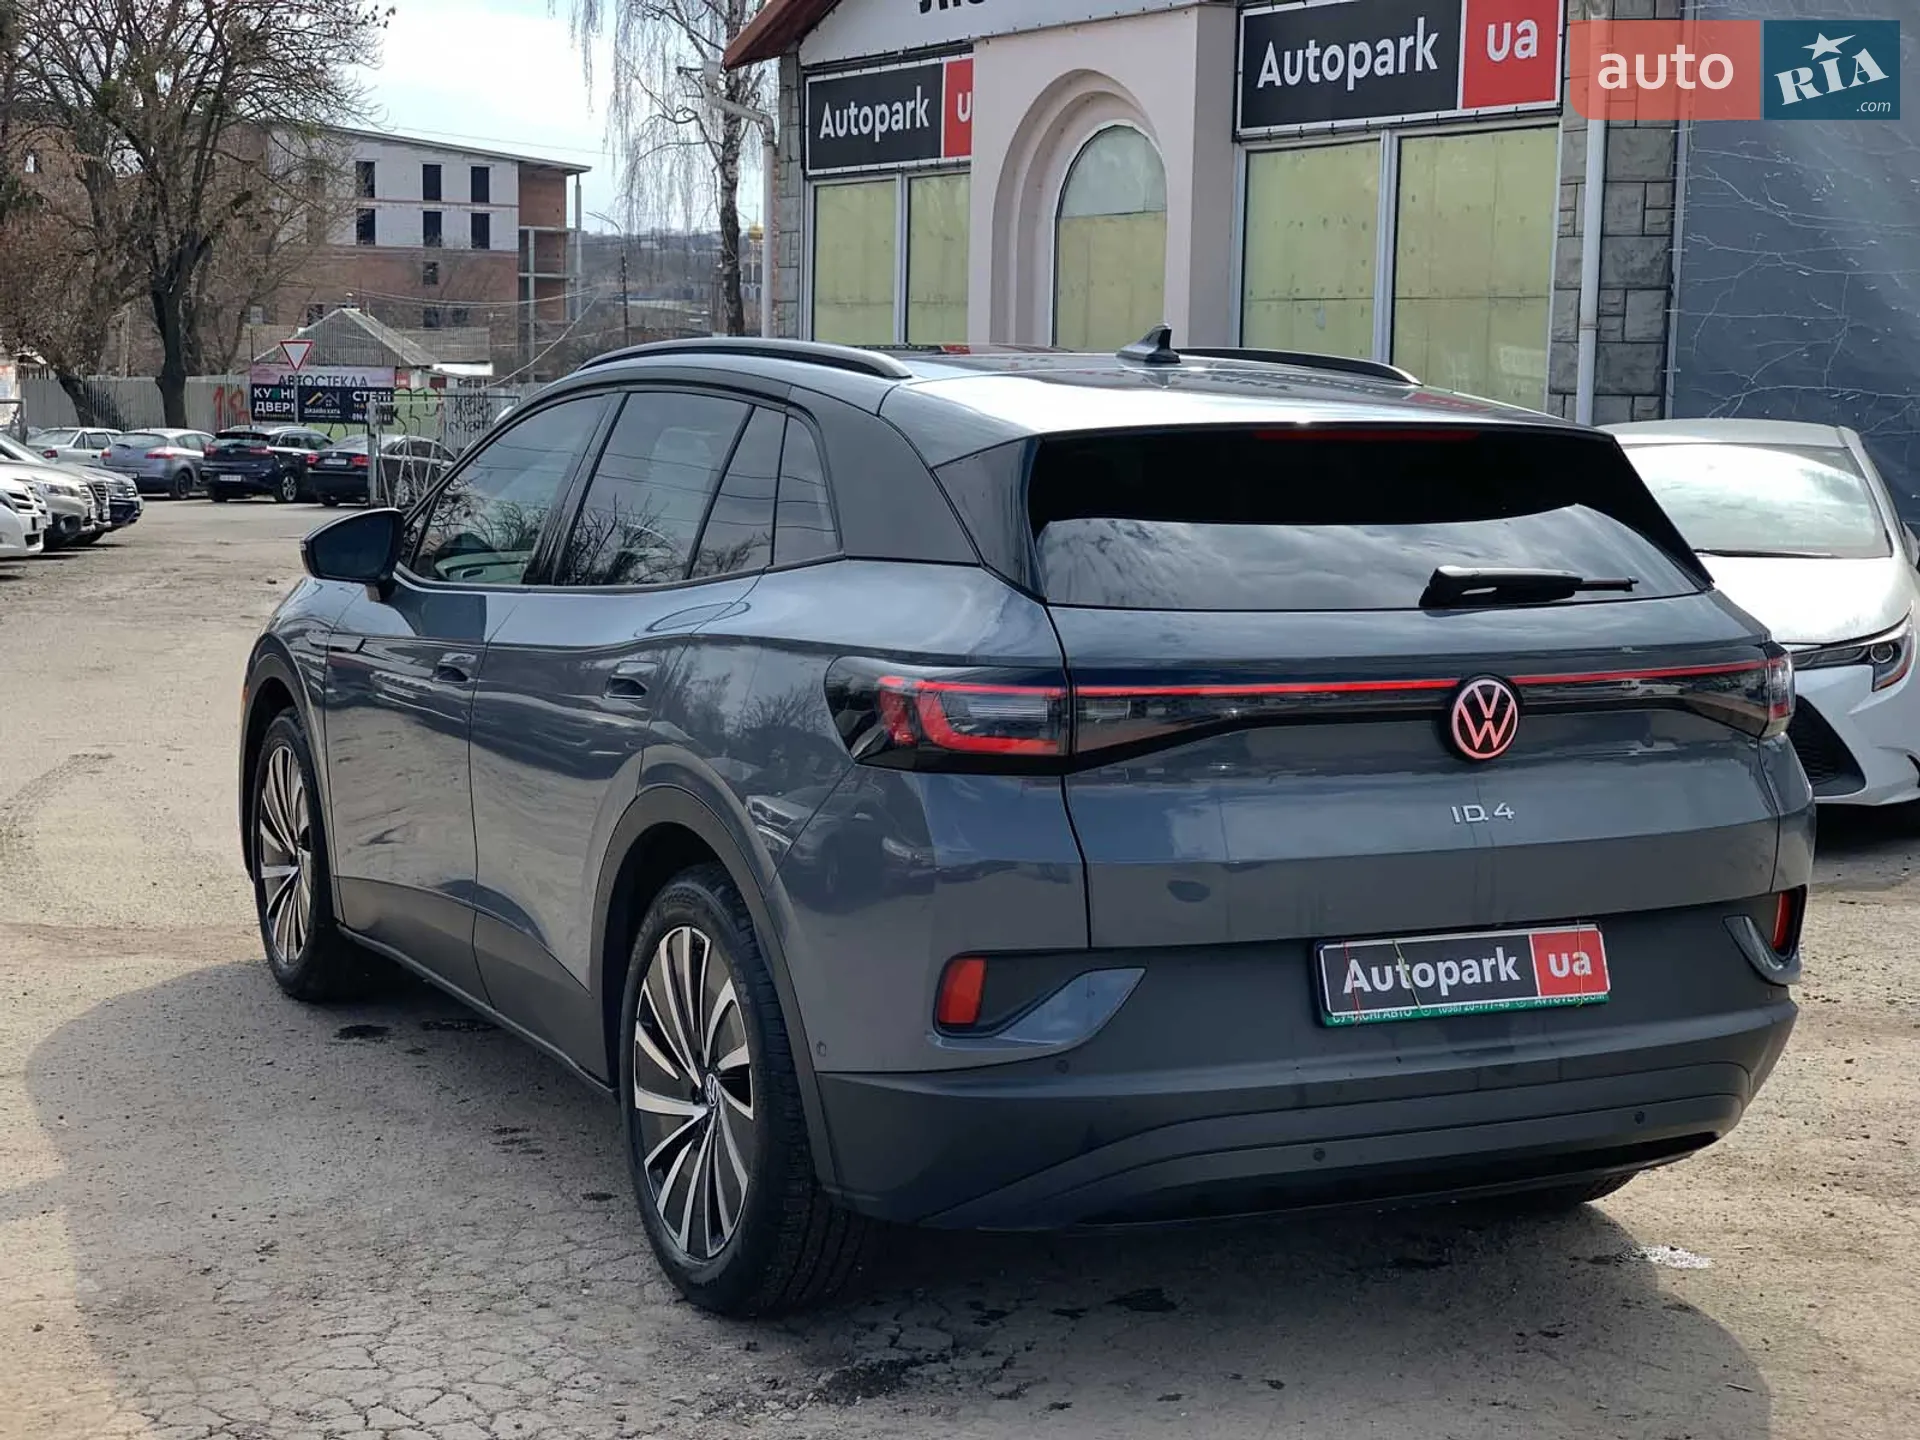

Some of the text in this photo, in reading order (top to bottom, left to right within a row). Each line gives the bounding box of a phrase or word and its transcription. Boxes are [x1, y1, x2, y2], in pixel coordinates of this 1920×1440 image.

[1257, 16, 1539, 91] Autopark ua
[819, 85, 930, 142] Autopark
[278, 374, 368, 388] АВТОСТЕКЛА
[254, 401, 294, 414] ДВЕРІ
[1450, 803, 1516, 824] ID.4
[1343, 946, 1592, 996] Autopark ua
